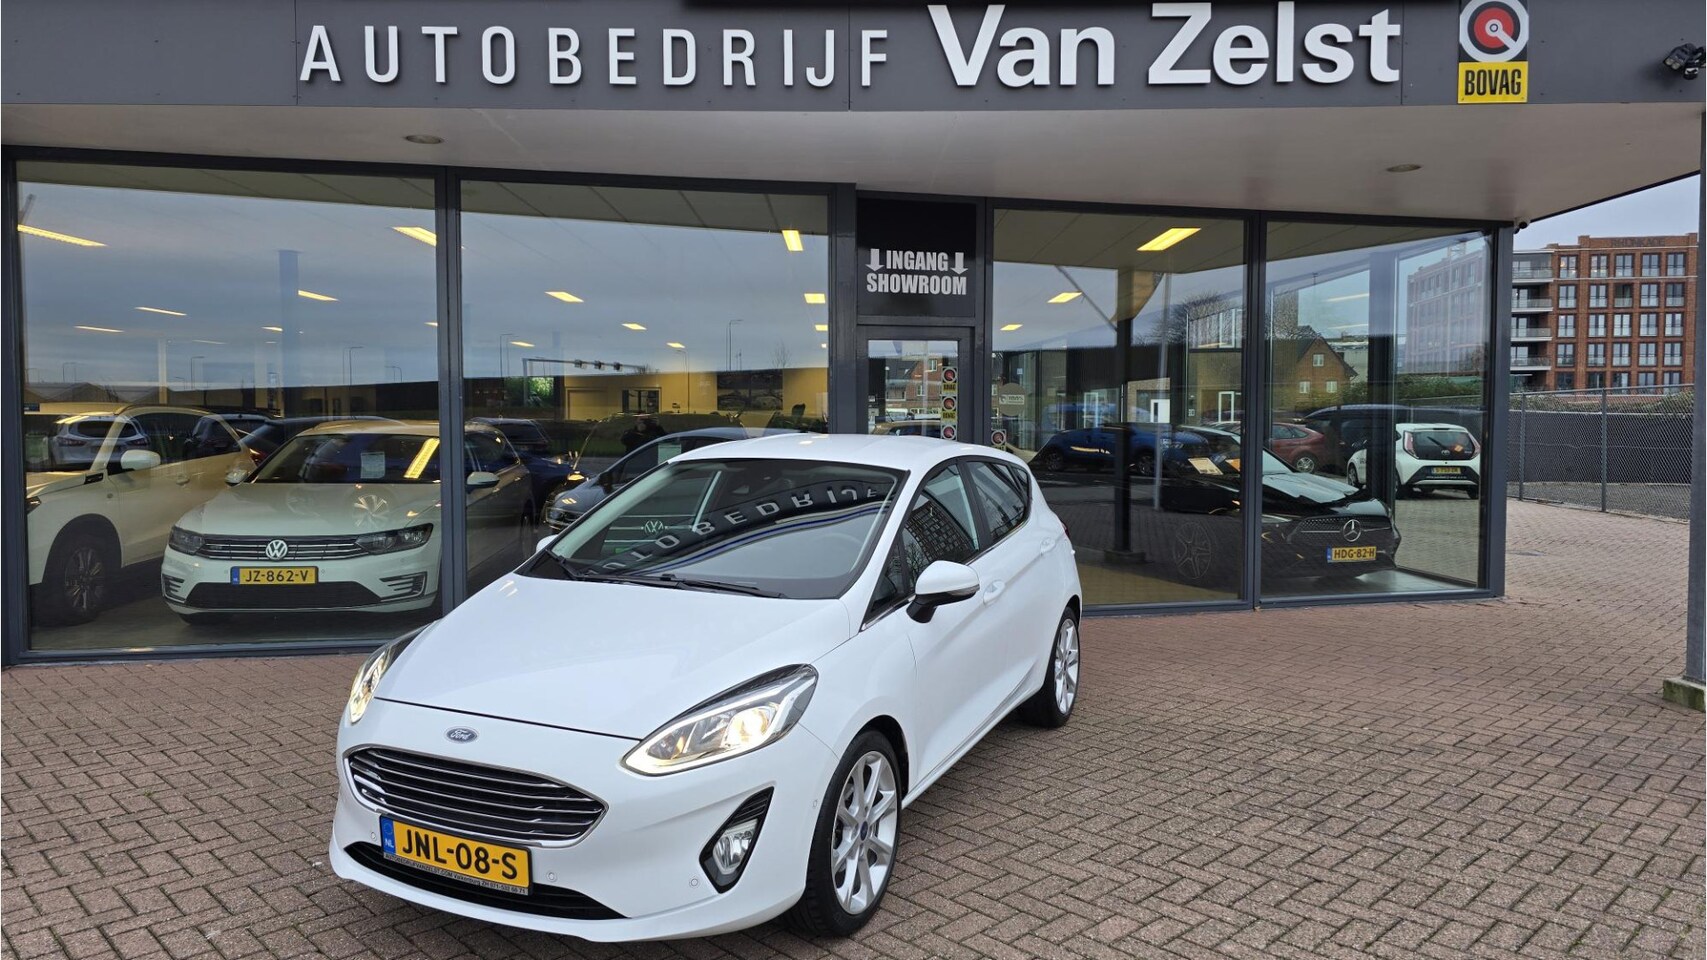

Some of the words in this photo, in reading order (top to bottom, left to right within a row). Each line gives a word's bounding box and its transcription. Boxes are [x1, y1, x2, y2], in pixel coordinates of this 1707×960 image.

[300, 25, 888, 88] AUTOBEDRIJF
[927, 4, 1115, 87] Van
[1148, 2, 1401, 85] Zelst
[1464, 68, 1522, 96] BOVAG
[886, 249, 949, 271] INGANG
[866, 272, 967, 295] SHOWROOM
[1334, 547, 1375, 559] HDG-82-H
[245, 569, 309, 582] JZ-862-V
[450, 729, 472, 741] Ford
[384, 837, 395, 849] NL
[402, 829, 518, 881] JNL-08-S
